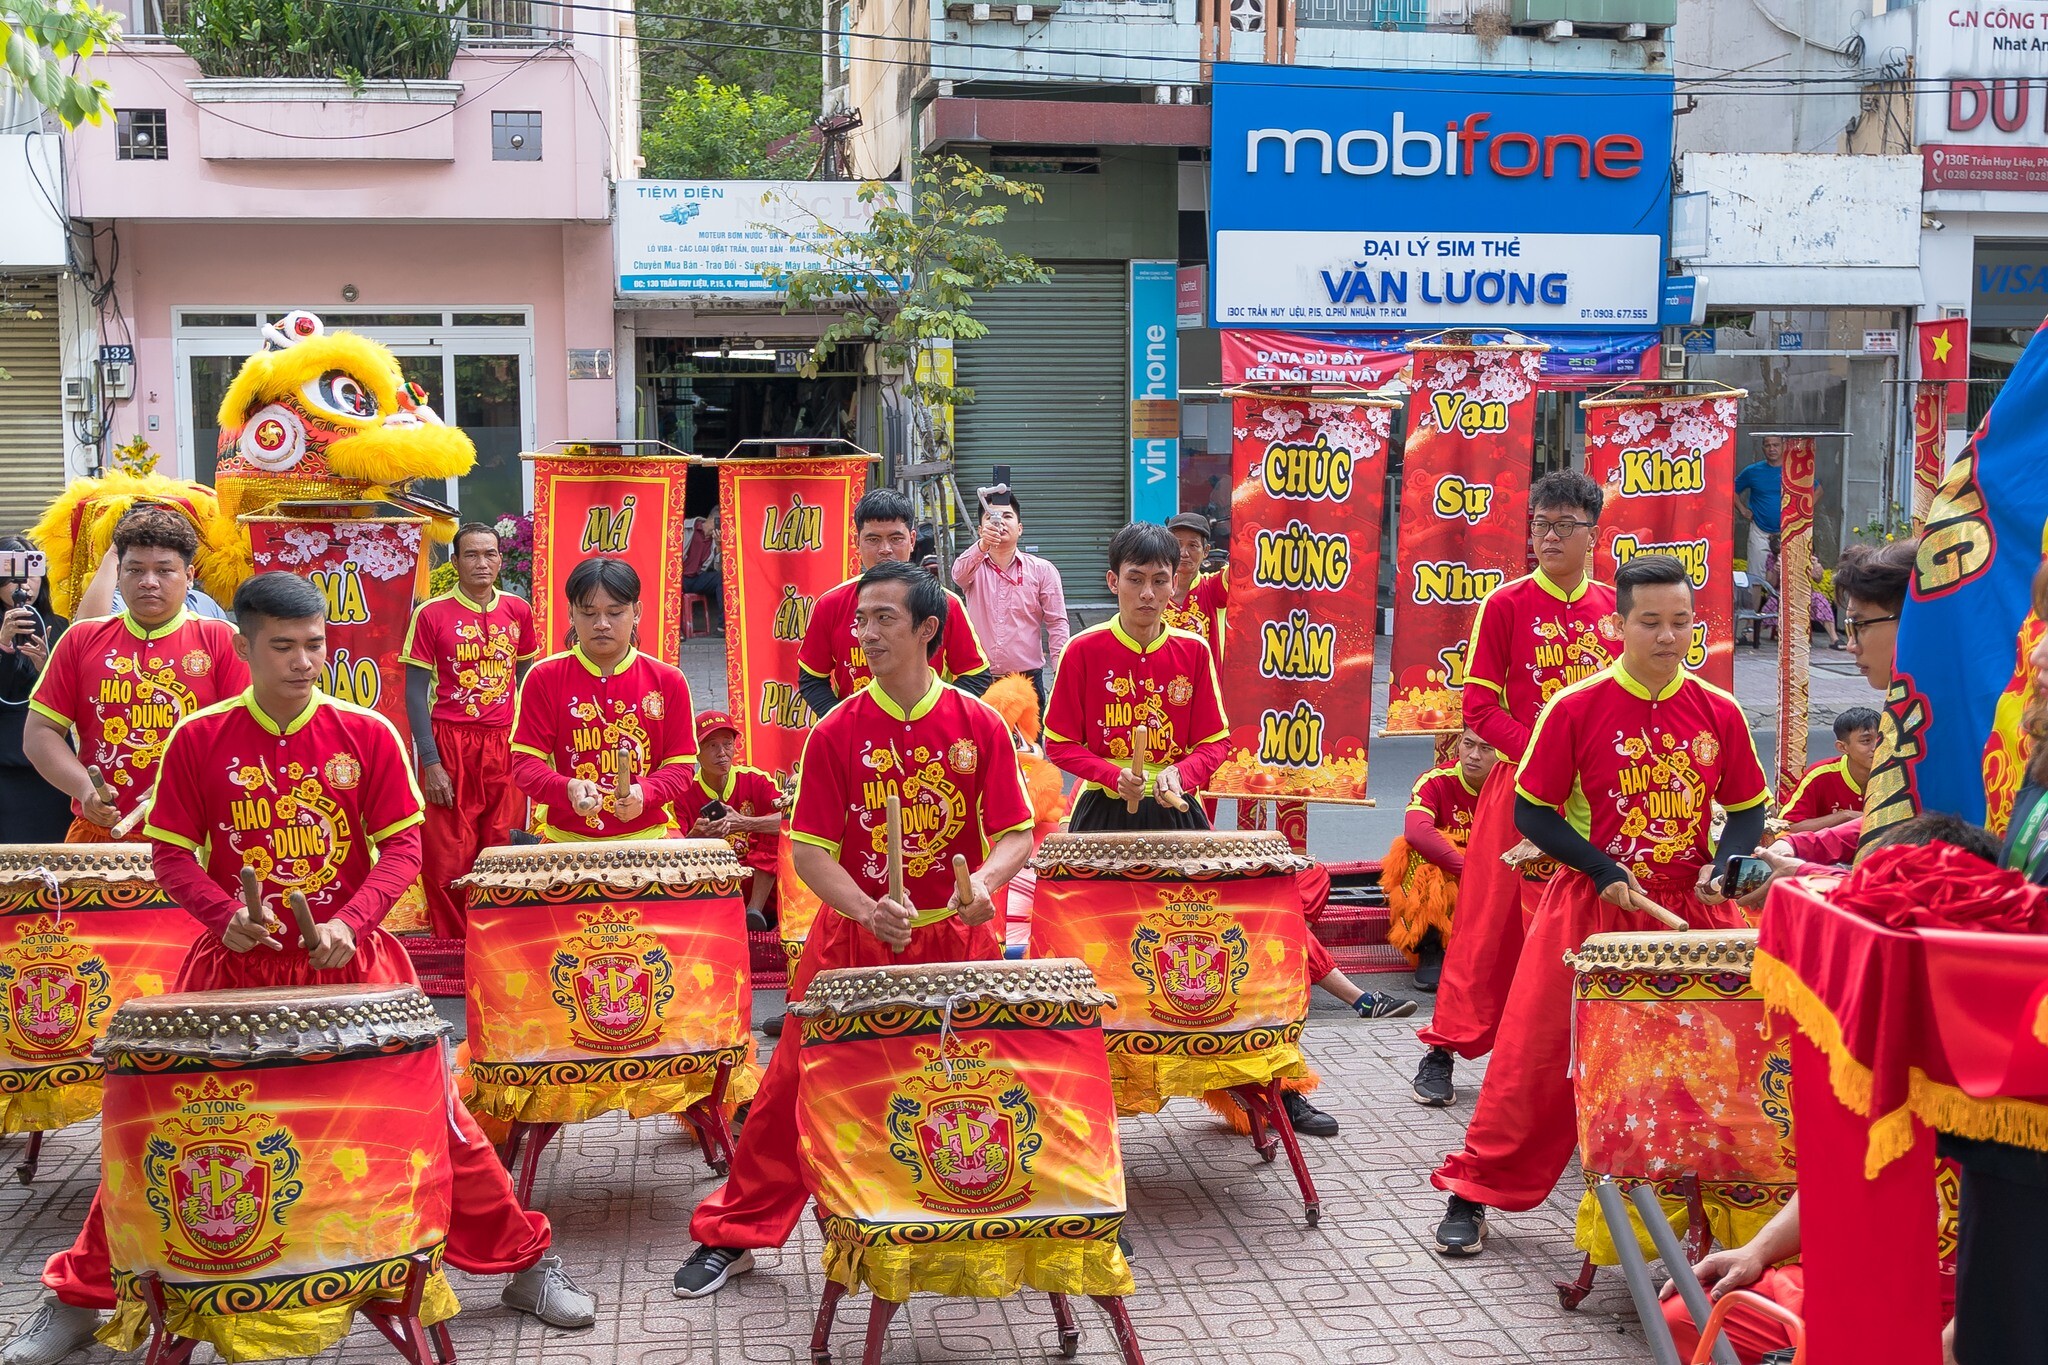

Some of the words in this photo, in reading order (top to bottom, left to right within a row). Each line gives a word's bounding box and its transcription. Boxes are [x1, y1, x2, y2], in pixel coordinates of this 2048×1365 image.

[1948, 10, 1978, 28] C.N
[1984, 7, 2034, 29] CÔNG
[1993, 37, 2027, 50] Nhat
[1948, 78, 2048, 134] DU
[1246, 111, 1644, 179] mobifone
[1944, 155, 1969, 165] 130E
[1993, 157, 2012, 169] Huy
[1944, 170, 1968, 180] (028)
[1969, 170, 1993, 180] 6298
[1994, 170, 2019, 181] 8882
[637, 185, 677, 200] TIỆM
[684, 185, 724, 200] ĐIỆN
[699, 231, 725, 239] MOTEUR
[1364, 240, 1399, 260] ĐẠI
[1408, 236, 1430, 256] LÝ
[1437, 240, 1475, 257] SIM
[1481, 236, 1521, 257] THẺ
[634, 261, 662, 270] Chuyên
[664, 261, 680, 269] Mua
[683, 260, 697, 269] Bán
[706, 260, 722, 269] Trao
[725, 259, 736, 269] Đổi
[785, 261, 800, 271] Máy
[647, 280, 659, 288] 130
[679, 280, 691, 288] HUY
[1320, 261, 1407, 304] VĂN
[1421, 269, 1568, 306] LƯƠNG
[1227, 308, 1245, 317] 130C
[1248, 304, 1267, 317] TRẦN
[1271, 308, 1285, 317] HUY
[1289, 306, 1306, 319] LIỆU,
[1350, 307, 1375, 319] NHUẬN
[1580, 310, 1592, 319] ĐT:
[102, 347, 130, 359] 132
[1257, 351, 1300, 364] DATA
[1303, 349, 1328, 365] ĐỦ
[1330, 351, 1364, 366] ĐẦY
[1568, 358, 1582, 366] 25
[1245, 366, 1276, 380] KẾT
[1278, 366, 1308, 381] NỐI
[1311, 370, 1346, 381] SUM
[1348, 367, 1382, 382] VẦY
[1140, 325, 1166, 484] vinhone
[1434, 392, 1507, 435] Vạn
[1265, 436, 1352, 499] CHÚC
[1621, 448, 1703, 495] Khai
[1436, 476, 1491, 523] Sự
[582, 495, 637, 552] MÃ
[762, 493, 822, 552] LÀM
[1256, 522, 1348, 588] MỪNG
[1415, 563, 1500, 602] Như
[774, 586, 814, 641] ĂN
[456, 639, 480, 661] HÀO
[1262, 610, 1334, 679] NĂM
[1535, 640, 1563, 667] HÀO
[479, 655, 507, 678] DŨNG
[100, 673, 132, 704] HÀO
[131, 699, 174, 729] DŨNG
[1105, 697, 1132, 727] HÀO
[572, 722, 601, 752] HÀO
[1260, 701, 1322, 766] MỚI
[1618, 761, 1650, 796] HÀO
[231, 792, 271, 831] HÀO
[1649, 783, 1691, 819] DŨNG
[901, 798, 940, 835] DŨNG
[273, 818, 326, 859] DŨNG
[1166, 904, 1181, 912] HO
[1184, 903, 1213, 912] YONG
[21, 936, 35, 945] HO
[38, 934, 69, 943] YONG
[584, 925, 600, 934] HO
[602, 924, 634, 933] YONG
[36, 945, 53, 953] 2005
[1205, 970, 1222, 993] 勇
[58, 1002, 76, 1026] 勇
[627, 992, 646, 1016] 勇
[924, 1061, 943, 1072] HO
[949, 1058, 986, 1070] YONG
[182, 1103, 201, 1114] HO
[204, 1101, 246, 1113] YONG
[938, 1101, 961, 1113] VIET
[962, 1101, 985, 1112] NAM
[202, 1116, 225, 1126] 2005
[192, 1147, 214, 1159] VIET
[216, 1146, 240, 1160] NAM
[984, 1143, 1007, 1172] 勇
[233, 1192, 258, 1225] 勇
